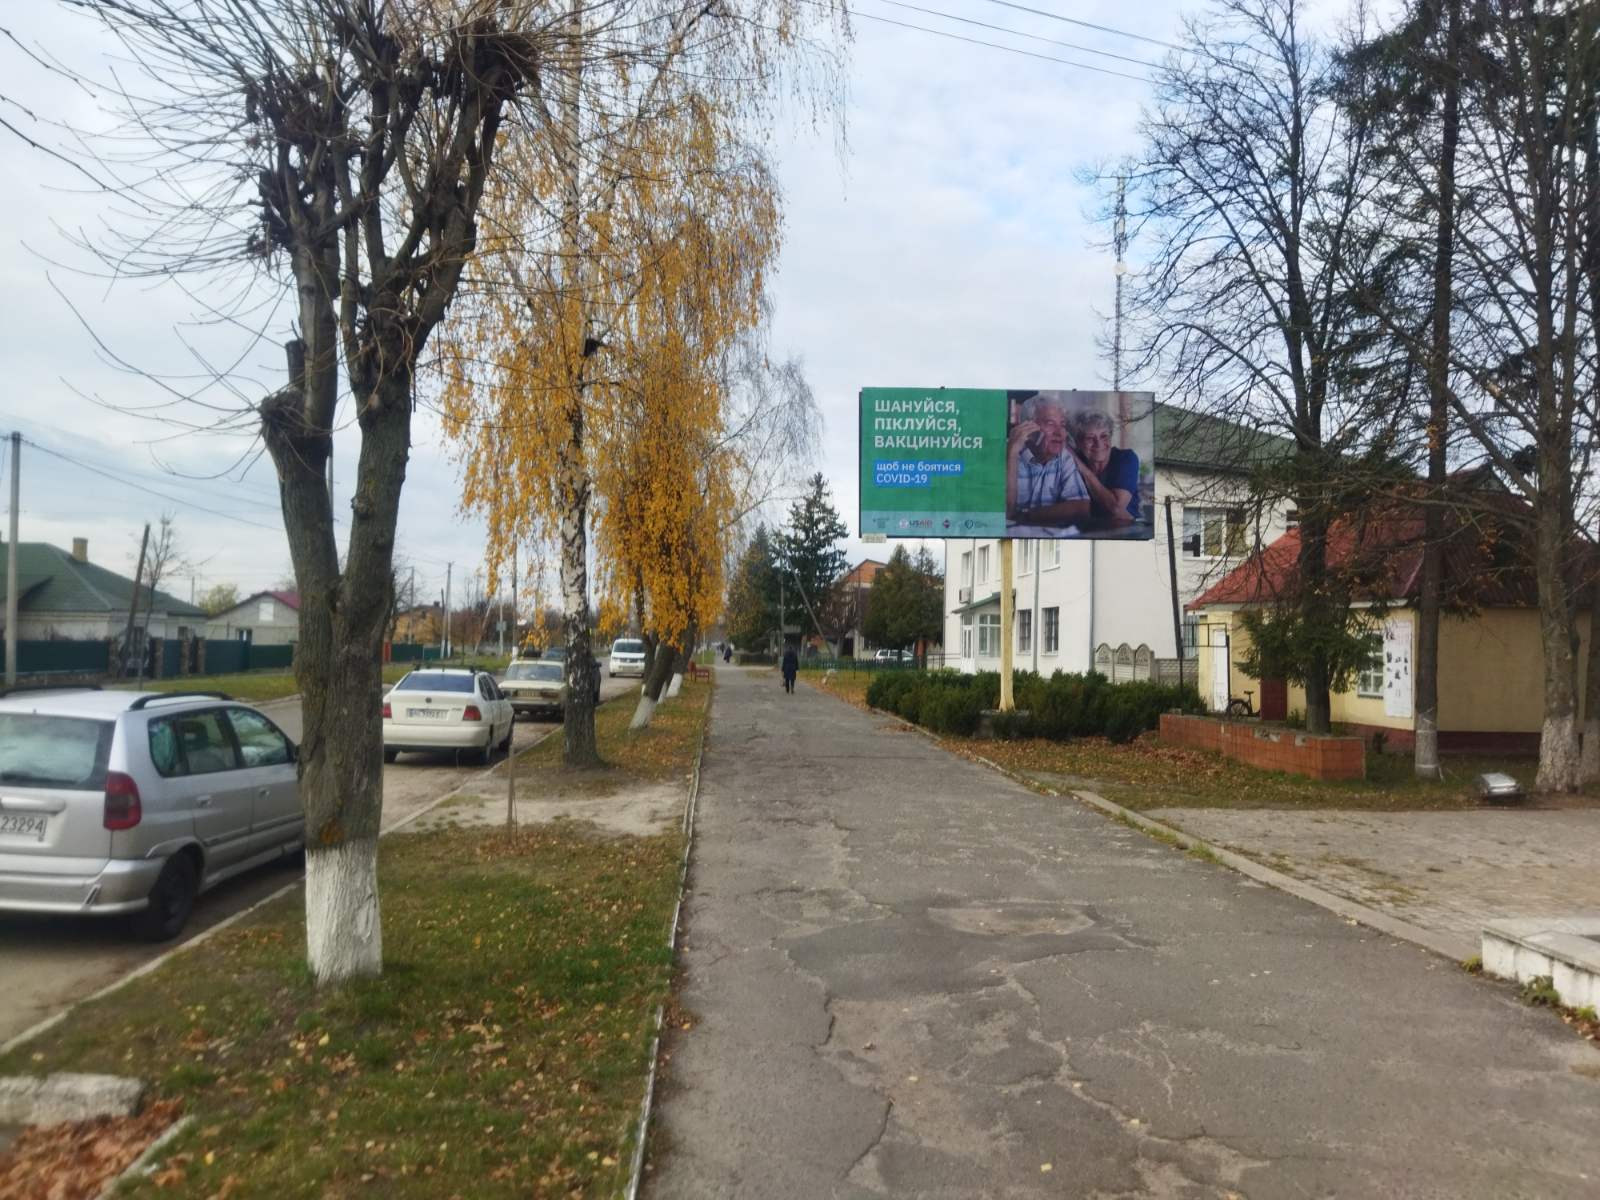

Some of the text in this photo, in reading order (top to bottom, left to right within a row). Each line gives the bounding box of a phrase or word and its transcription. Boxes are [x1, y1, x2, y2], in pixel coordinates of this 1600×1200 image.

[875, 397, 960, 415] ШАНУЙСЯ,
[874, 415, 961, 432] ПІКЛУЙСЯ,
[874, 433, 983, 450] ВАКЦИНУЙСЯ
[876, 461, 961, 472] щоб не боятися
[876, 474, 928, 484] COVID-19
